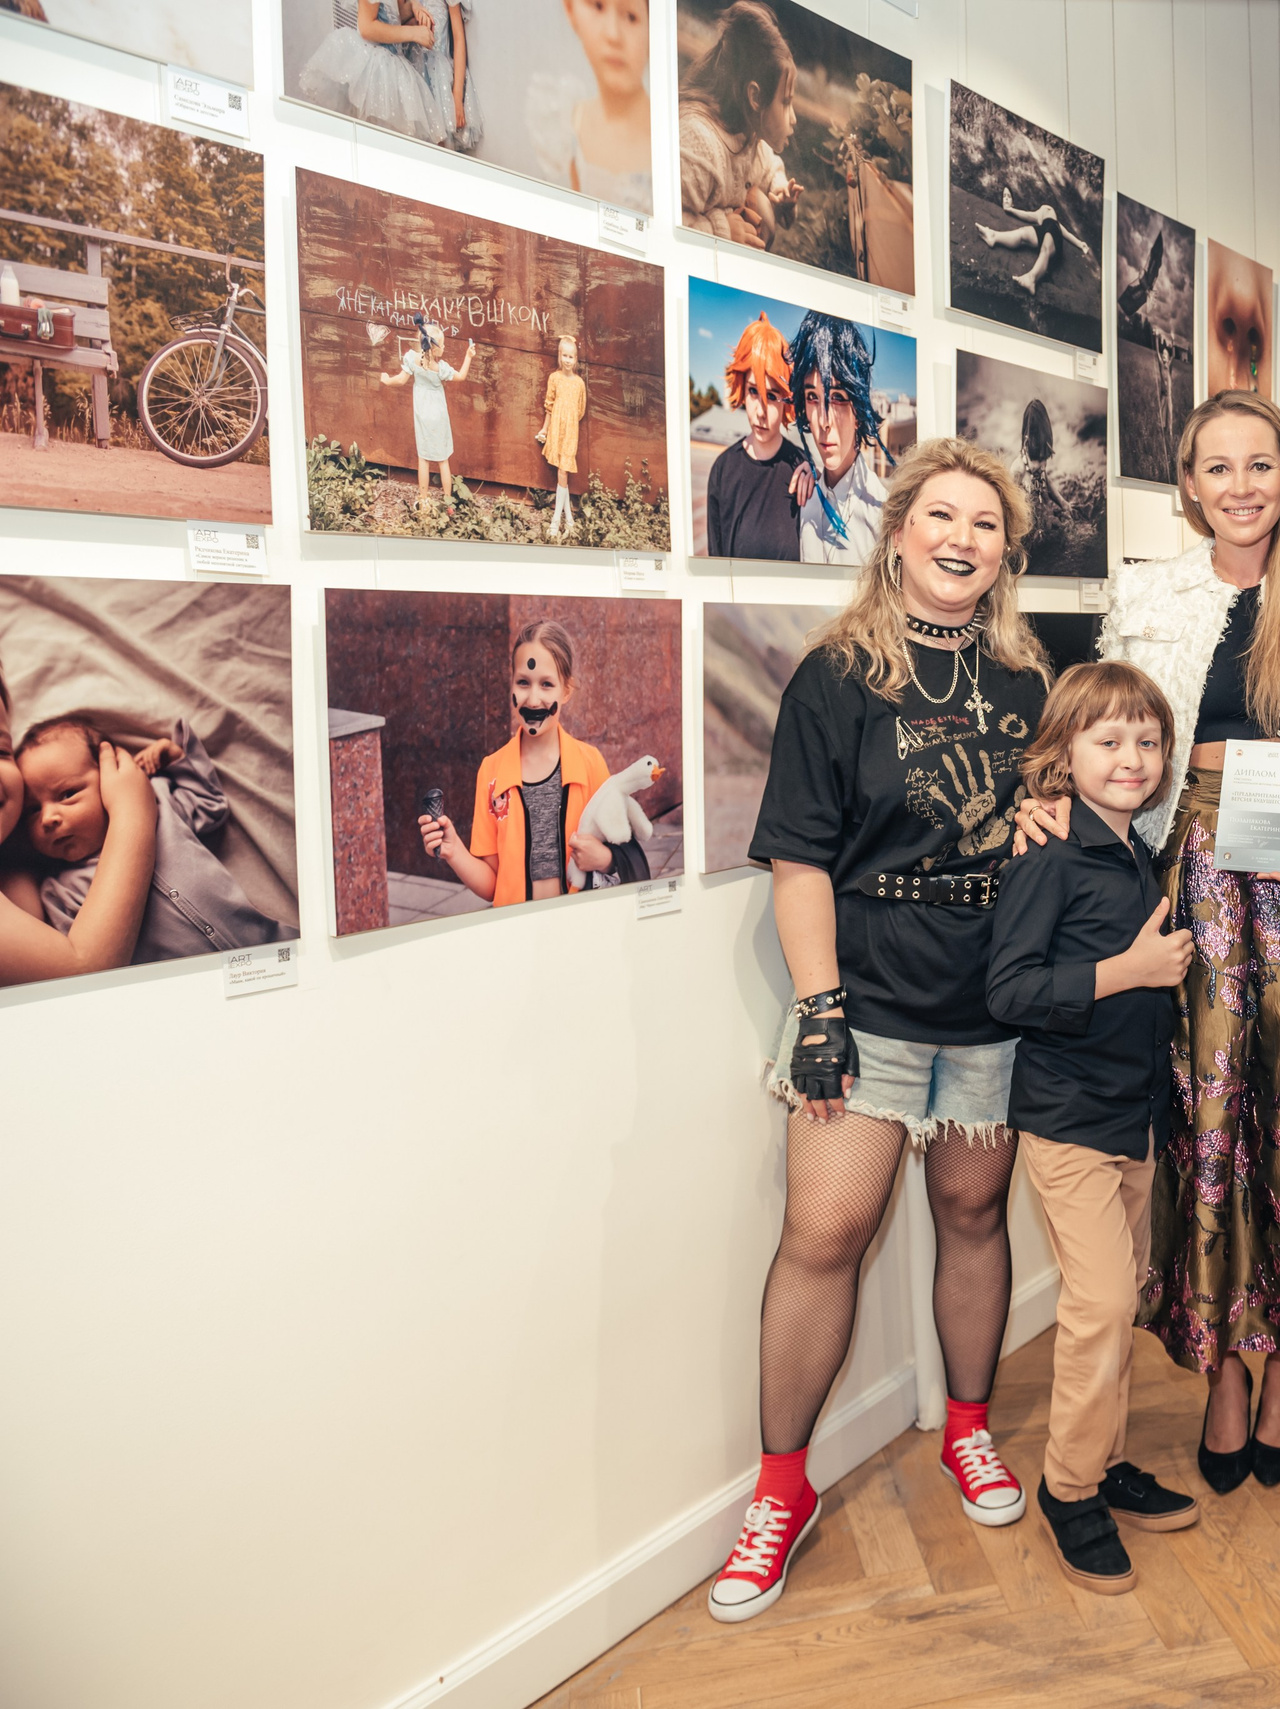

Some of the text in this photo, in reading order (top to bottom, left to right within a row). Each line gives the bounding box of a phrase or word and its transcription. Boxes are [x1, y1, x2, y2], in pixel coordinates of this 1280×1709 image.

[196, 529, 218, 539] ART
[911, 718, 936, 726] MADE
[1234, 769, 1276, 778] ДИПЛОМ
[1229, 816, 1271, 825] ПОЗДНЯКОВА
[231, 953, 252, 963] ART
